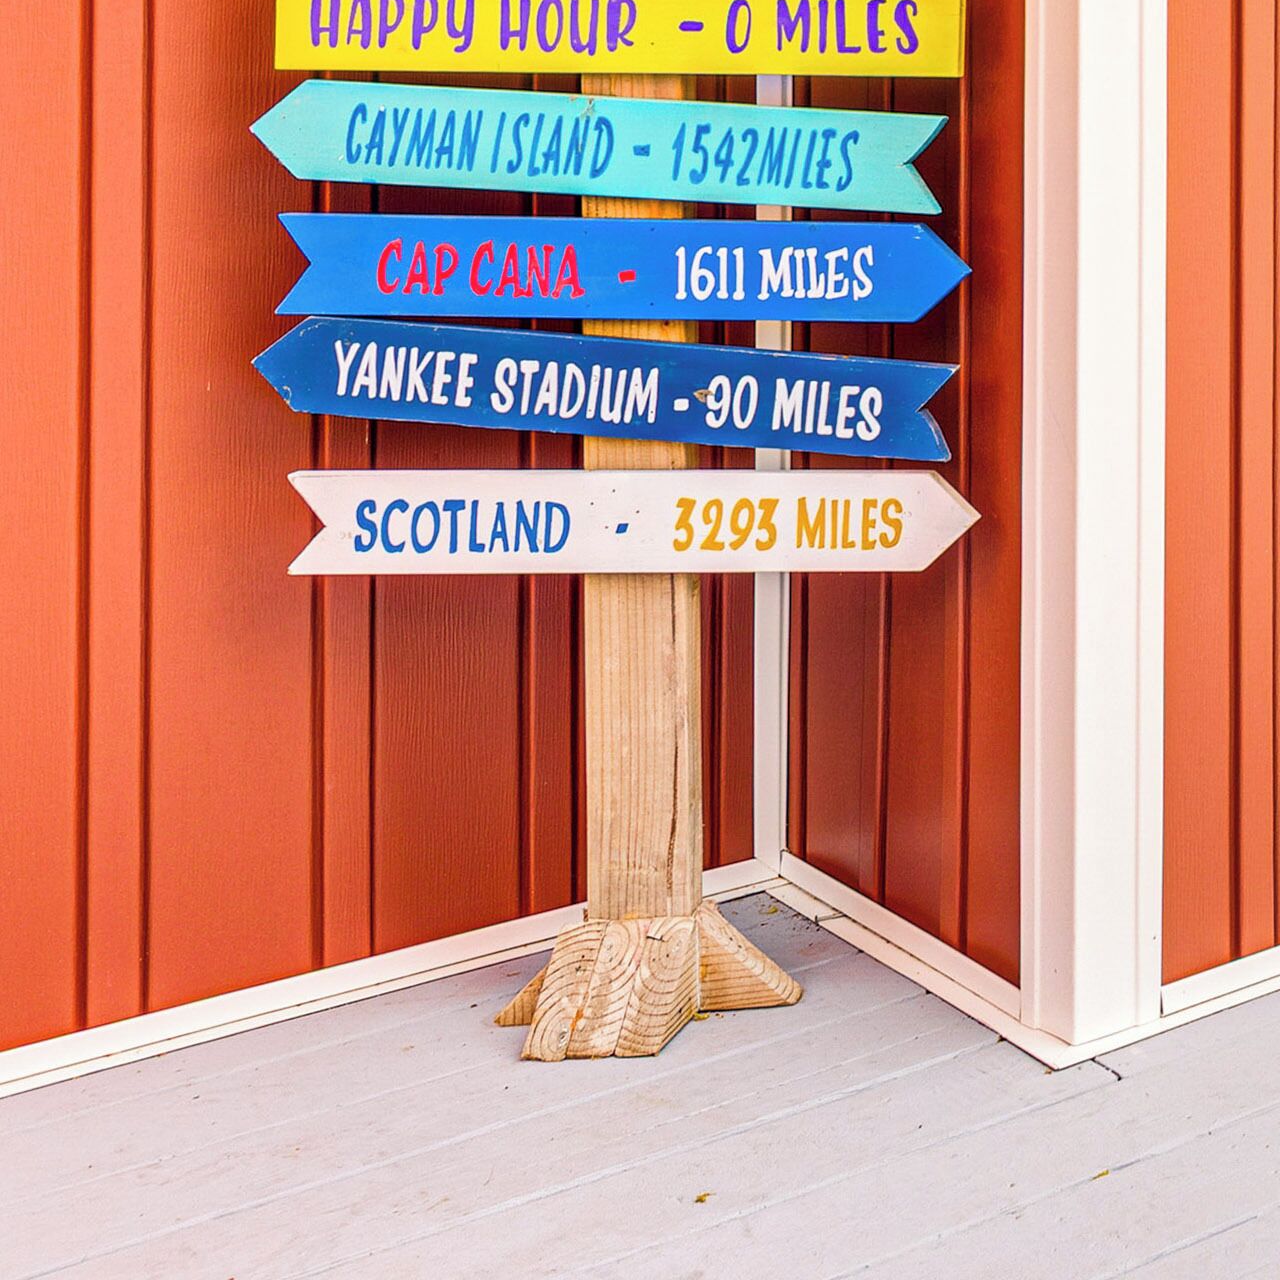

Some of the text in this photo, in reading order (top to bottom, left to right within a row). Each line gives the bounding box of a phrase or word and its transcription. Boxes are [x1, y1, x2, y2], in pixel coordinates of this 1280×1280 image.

[346, 103, 483, 171] CAYMAN
[491, 115, 614, 179] ISLAND
[377, 239, 459, 295] CAP
[470, 240, 585, 298] CANA
[676, 246, 745, 300] 1611
[757, 245, 873, 301] MILES
[335, 340, 477, 407] YANKEE
[491, 358, 658, 423] STADIUM
[772, 378, 882, 441] MILES
[354, 499, 570, 554] SCOTLAND
[673, 497, 779, 552] 3293
[796, 497, 903, 550] MILES
